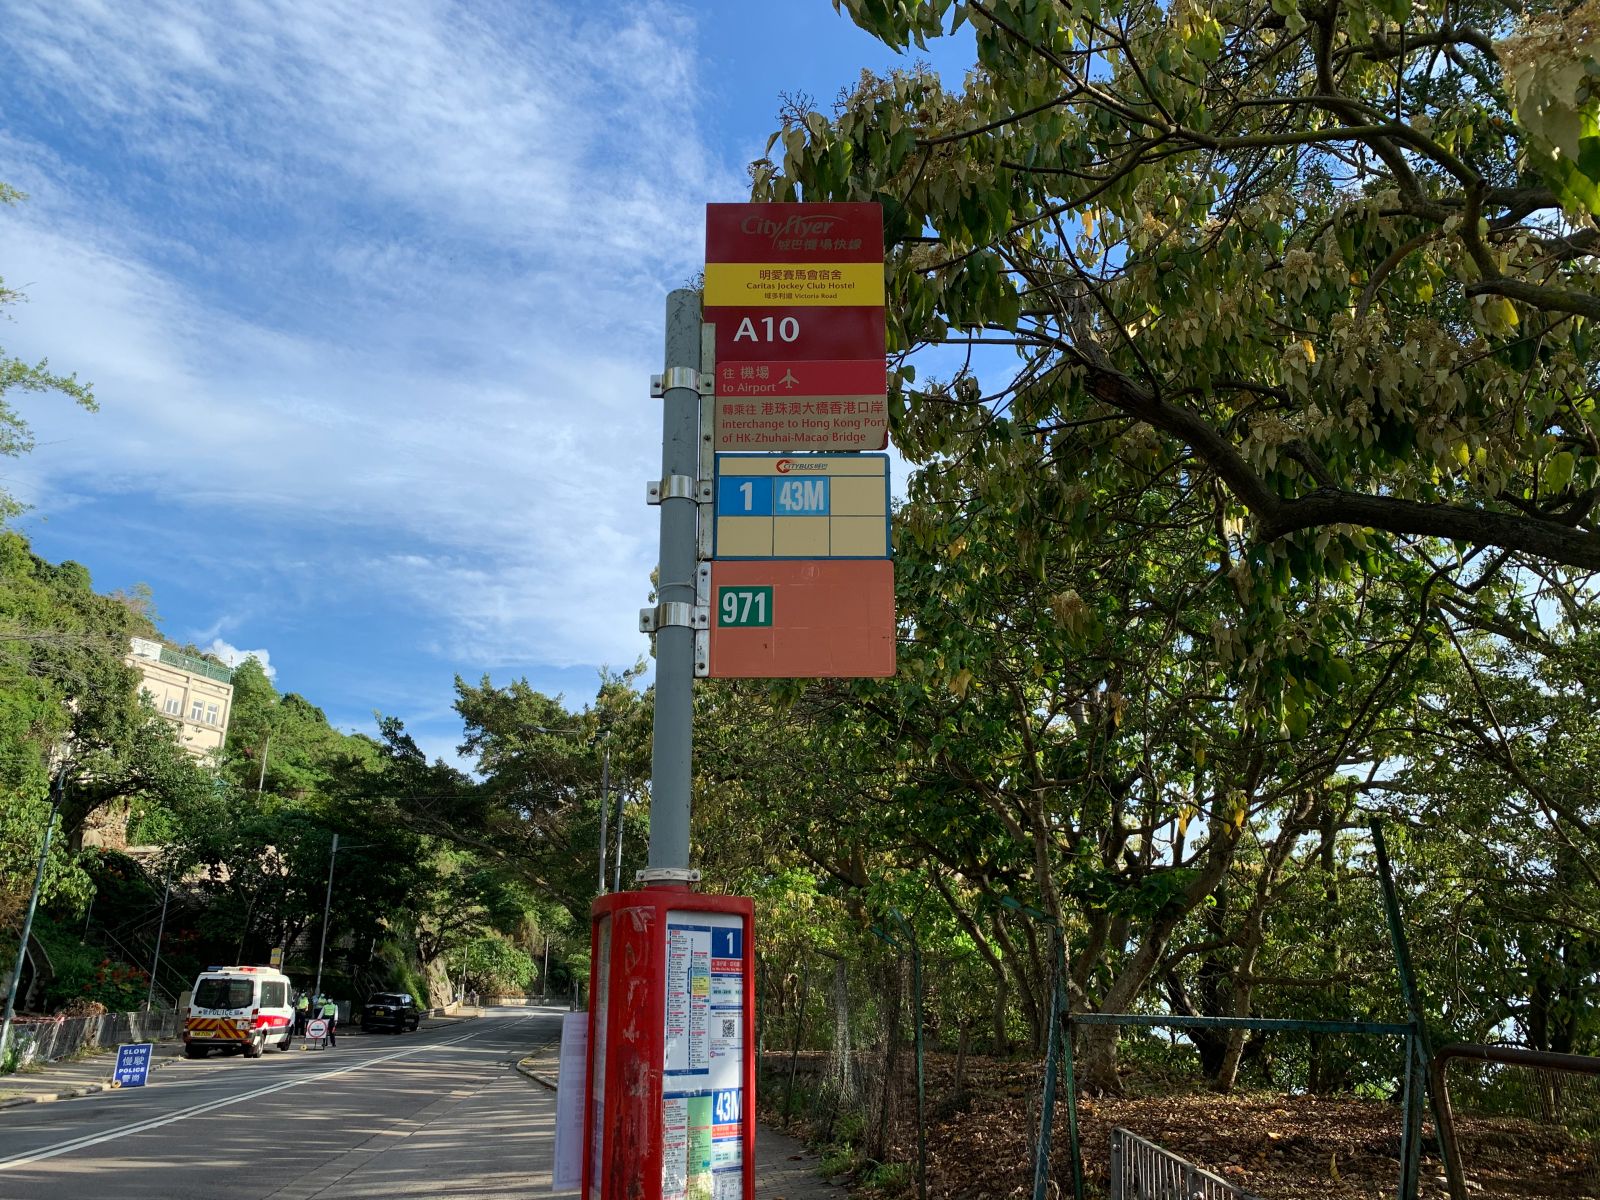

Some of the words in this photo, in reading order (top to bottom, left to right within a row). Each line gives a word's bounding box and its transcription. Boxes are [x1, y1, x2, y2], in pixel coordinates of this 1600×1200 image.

[759, 269, 842, 281] 明愛賽馬會宿舍
[746, 282, 775, 290] Caritas
[777, 282, 804, 291] Jockey
[806, 282, 826, 290] Club
[828, 281, 855, 289] Hostel
[733, 316, 800, 342] A10
[722, 367, 735, 379] 往
[740, 365, 769, 380] 機場
[722, 383, 734, 393] to
[737, 382, 777, 395] Airport
[761, 401, 884, 415] 港珠澳大橋香港口岸
[722, 419, 785, 430] interchange
[788, 419, 798, 428] to
[802, 418, 830, 430] Hong
[833, 418, 861, 430] Kong
[864, 417, 886, 427] Port
[722, 433, 734, 443] of
[736, 432, 829, 443] HK-Zhuhai-Macao
[832, 431, 866, 444] Bridge
[739, 482, 753, 511] 1
[779, 480, 825, 511] 43M
[722, 592, 766, 623] 971
[726, 931, 734, 955] 1
[715, 1090, 743, 1122] 43M
